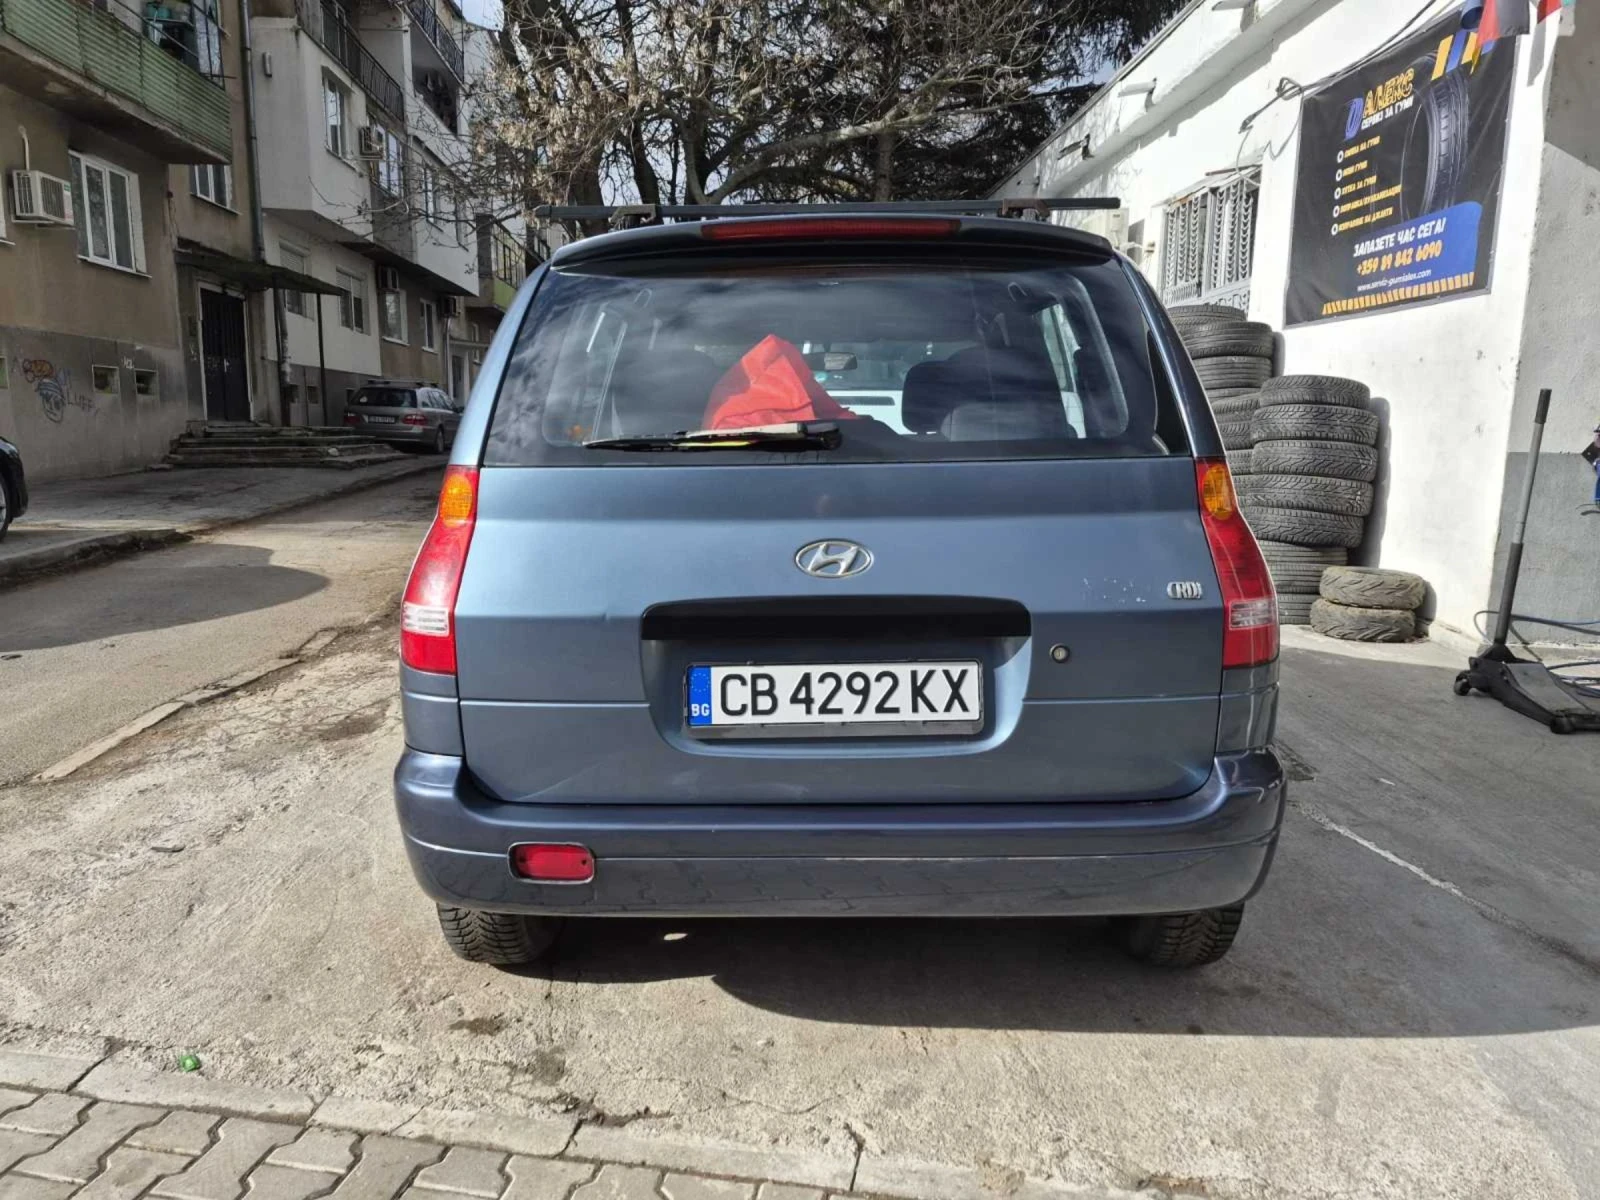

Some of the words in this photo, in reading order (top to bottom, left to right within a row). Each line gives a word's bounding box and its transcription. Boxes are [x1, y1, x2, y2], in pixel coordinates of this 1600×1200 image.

[1385, 105, 1394, 119] ЗА
[1394, 94, 1414, 115] ГУМИ
[1353, 233, 1396, 257] ЗАПАЗЕТЕ
[1397, 227, 1415, 245] ЧАС
[1417, 217, 1446, 239] СЕГА!
[1357, 256, 1379, 276] +359
[1380, 253, 1393, 271] 89
[1416, 240, 1443, 263] 6090
[690, 703, 710, 717] BG
[719, 673, 778, 716] CB
[789, 671, 900, 716] 4292
[910, 669, 969, 713] KX
